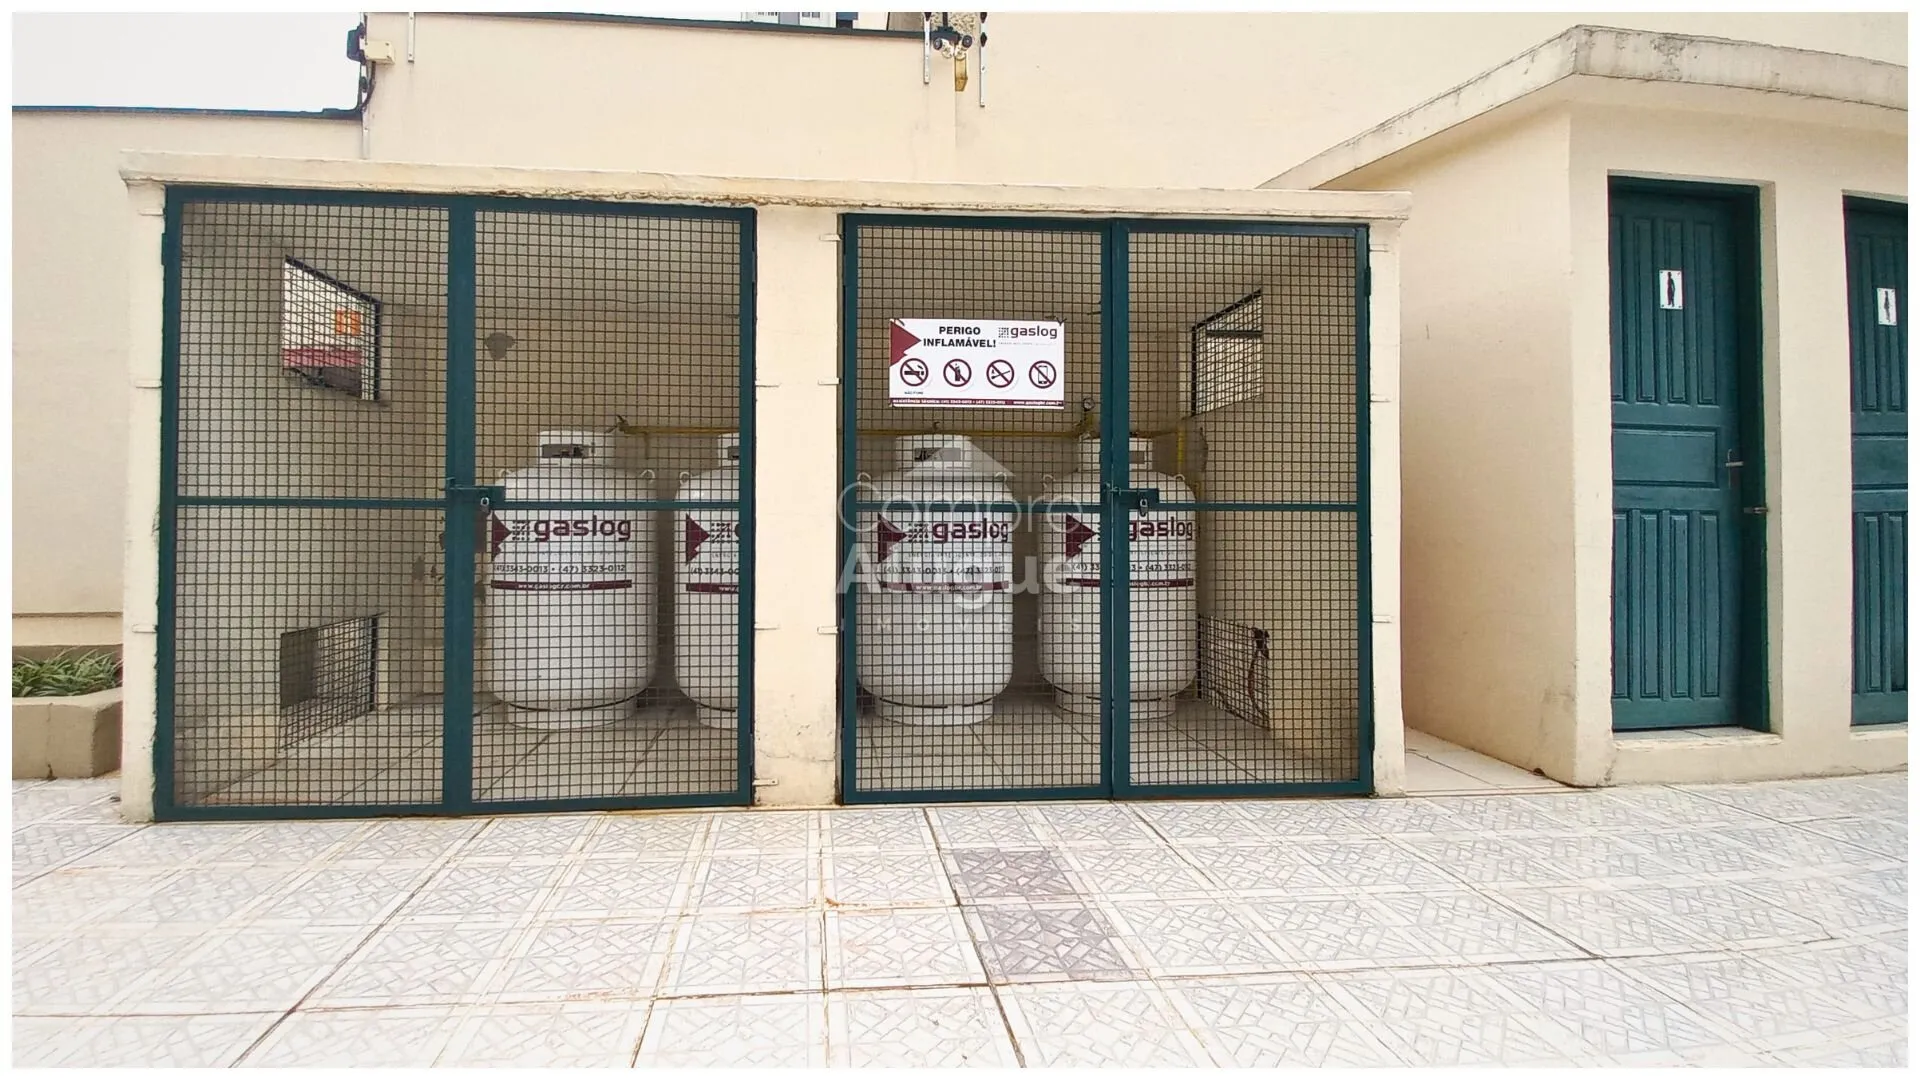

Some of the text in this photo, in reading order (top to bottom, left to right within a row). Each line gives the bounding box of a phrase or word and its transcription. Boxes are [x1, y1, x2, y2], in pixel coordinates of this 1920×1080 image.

[939, 326, 981, 335] PERIGO
[1011, 325, 1058, 340] gaslog
[923, 336, 997, 348] INFLAMÁVEL!
[534, 514, 631, 542] gaslog
[932, 517, 1008, 544] gaslog
